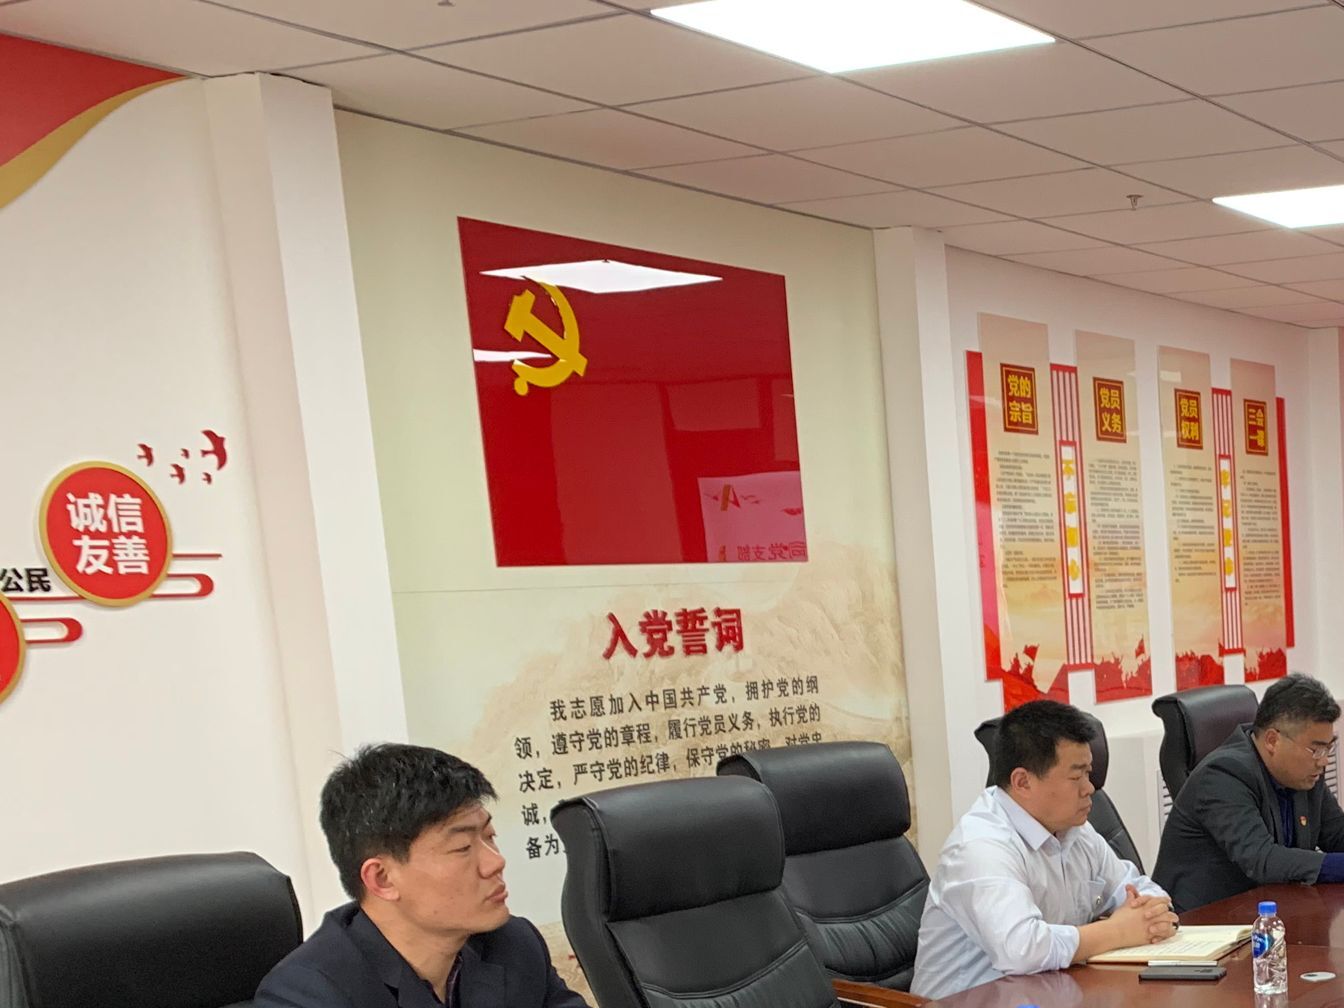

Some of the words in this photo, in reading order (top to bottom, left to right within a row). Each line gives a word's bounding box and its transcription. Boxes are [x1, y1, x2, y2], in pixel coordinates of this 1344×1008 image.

[1007, 374, 1031, 398] 党的
[1100, 387, 1121, 410] 党员
[1009, 401, 1033, 424] 宗旨
[1180, 398, 1198, 418] 党员
[1102, 412, 1122, 433] 义务
[66, 492, 145, 534] 诚信
[72, 535, 150, 576] 友善
[0, 567, 51, 594] 公民
[602, 606, 744, 660] 入党誓词
[525, 833, 566, 860] 备为
